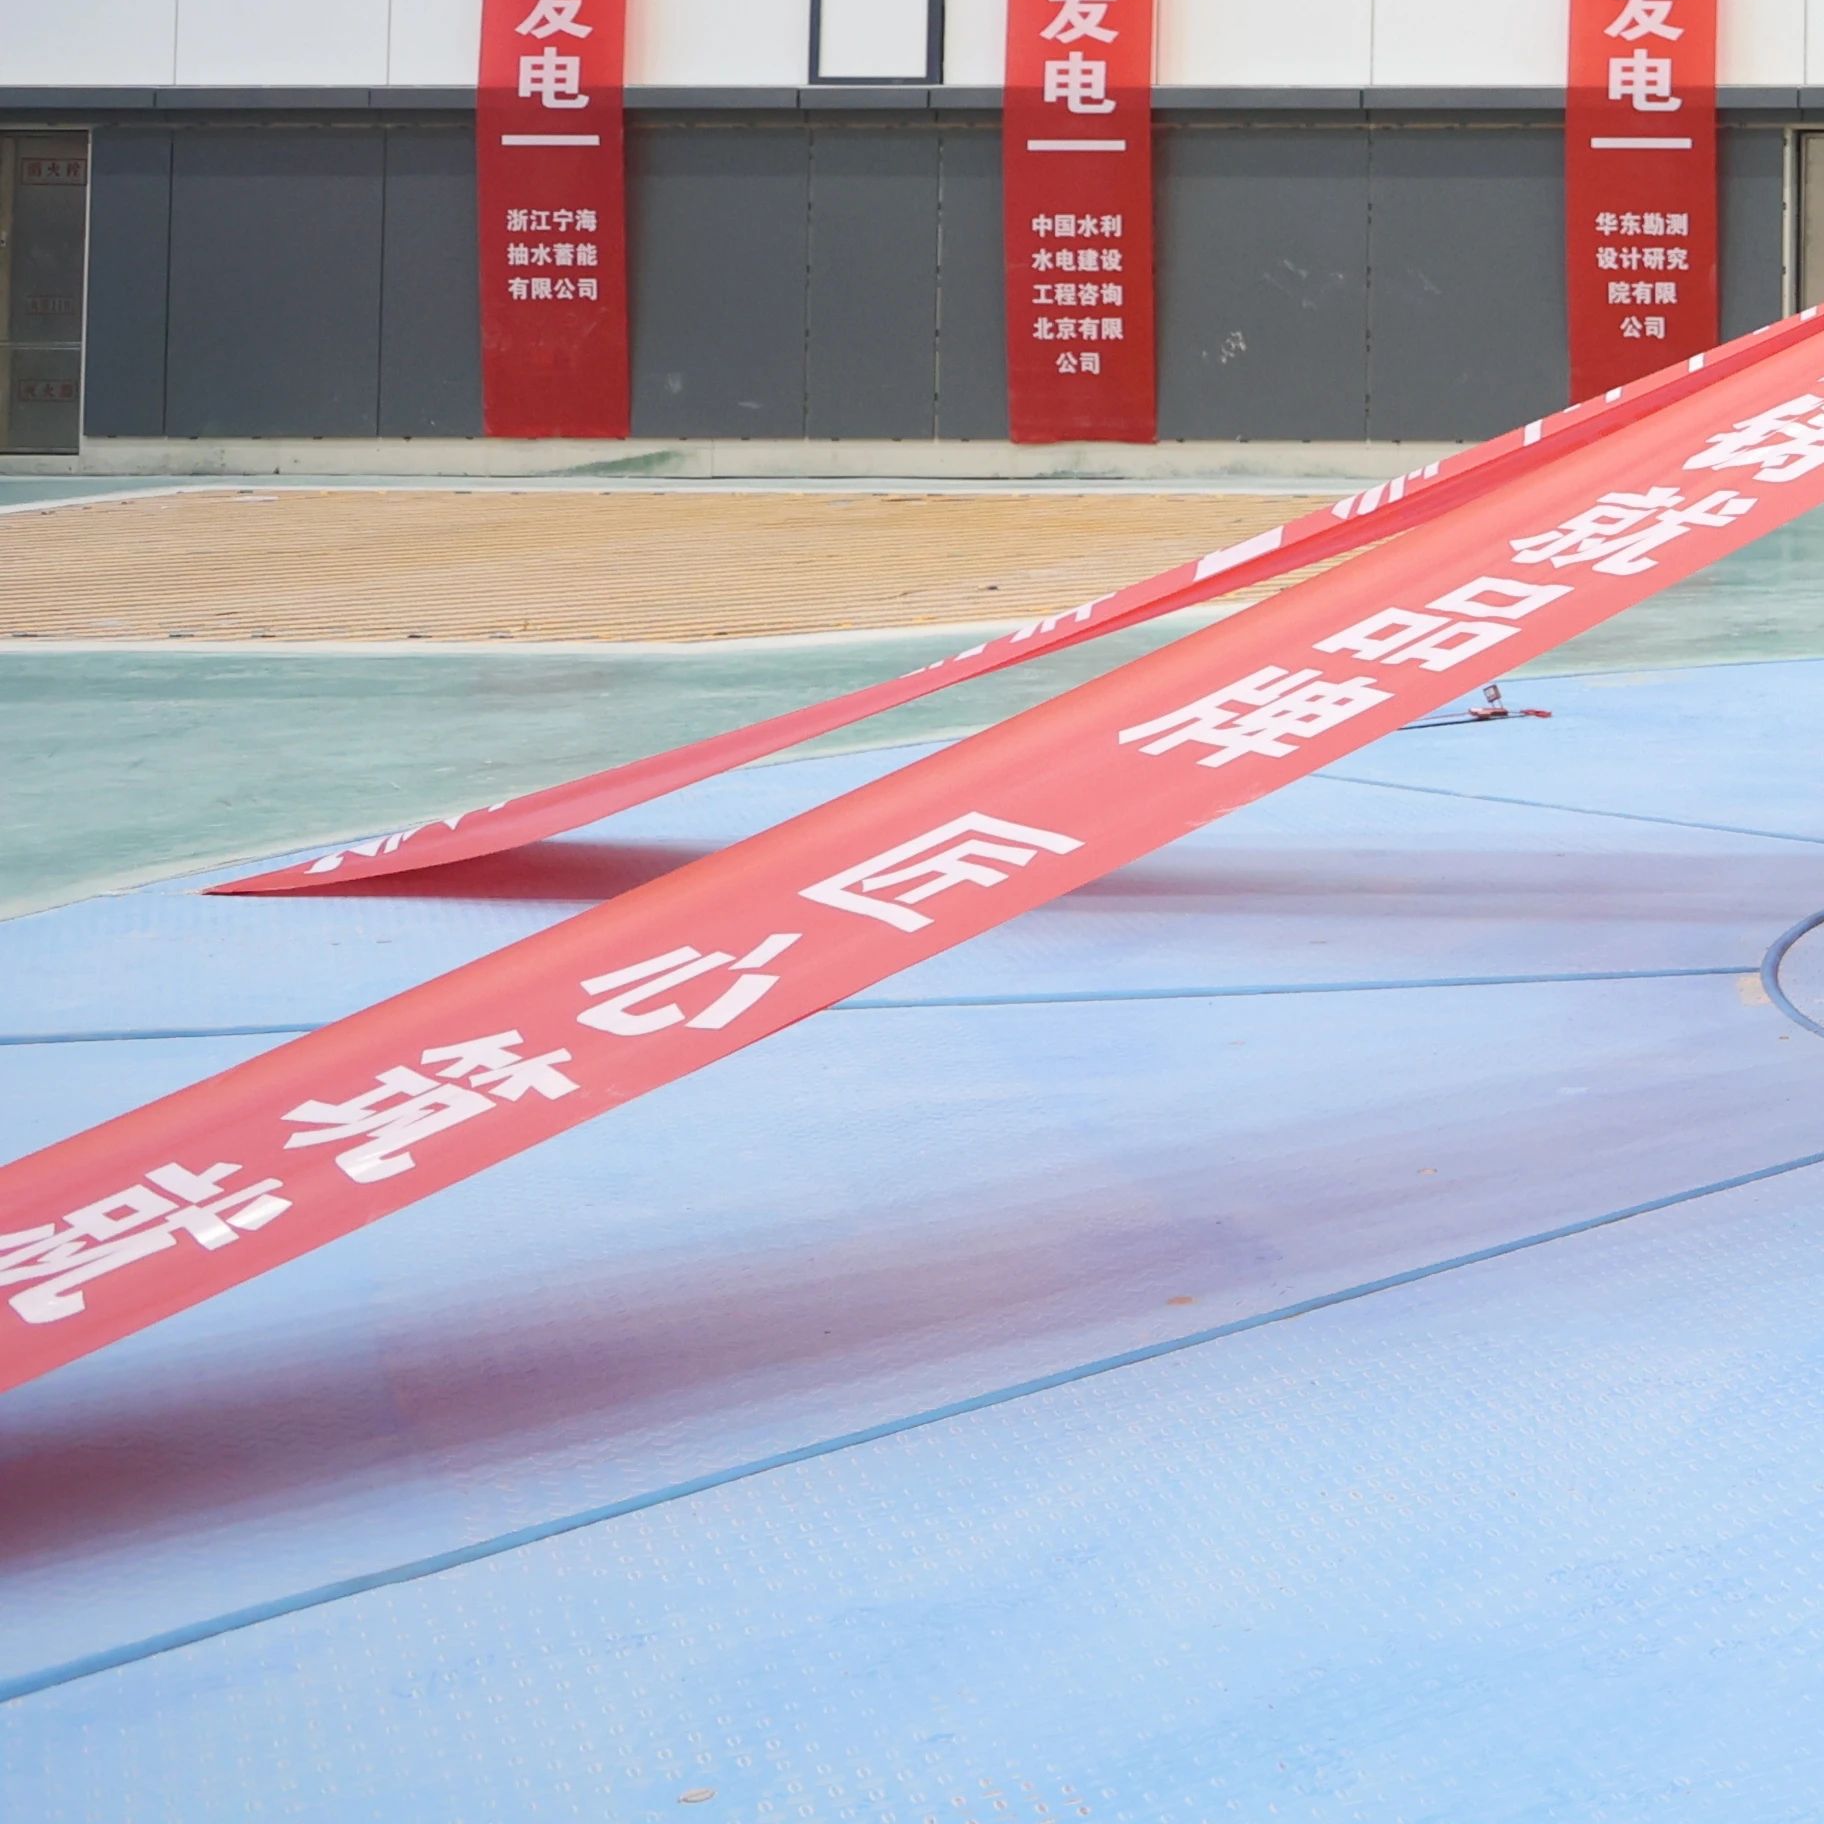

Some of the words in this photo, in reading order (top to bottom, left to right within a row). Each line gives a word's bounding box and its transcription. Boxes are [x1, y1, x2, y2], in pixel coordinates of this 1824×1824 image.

[507, 209, 597, 232] 浙江宁海
[1032, 214, 1122, 237] 中国水利
[1596, 212, 1688, 236] 华东勘测
[508, 243, 597, 266] 抽水蓄能
[1032, 249, 1122, 272] 水电建设
[1596, 247, 1688, 271] 设计研究
[508, 277, 598, 300] 有限公司
[1033, 283, 1123, 306] 工程咨询
[1608, 281, 1677, 305] 院有限
[1033, 317, 1123, 340] 北京有限
[1621, 316, 1665, 339] 公司
[1056, 352, 1101, 374] 公司
